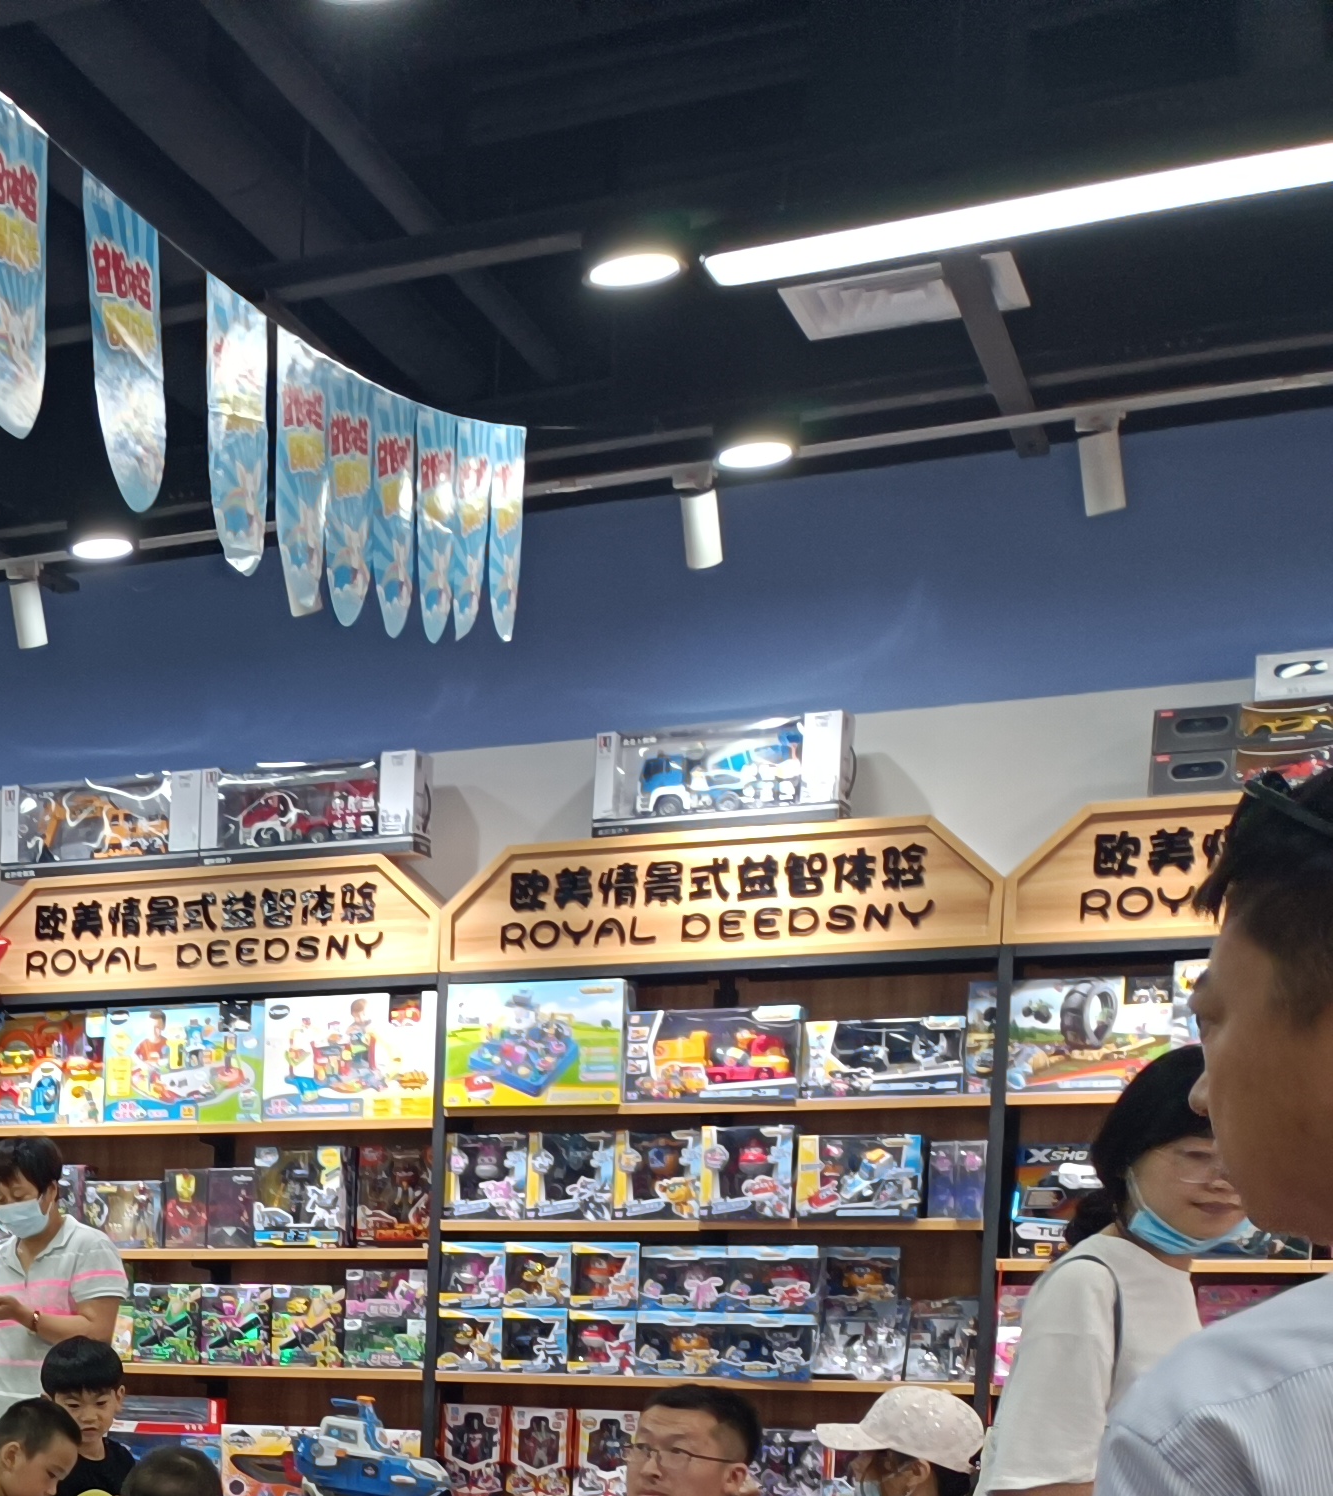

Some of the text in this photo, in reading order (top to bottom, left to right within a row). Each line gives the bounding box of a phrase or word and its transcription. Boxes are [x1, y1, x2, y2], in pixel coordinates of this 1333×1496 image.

[510, 843, 928, 912] 欧美情景式益智体验
[35, 882, 377, 941] 欧美情景式益智体验
[500, 899, 935, 954] ROYAL DEEDSNY
[25, 931, 384, 979] ROYAL DEEDSNY
